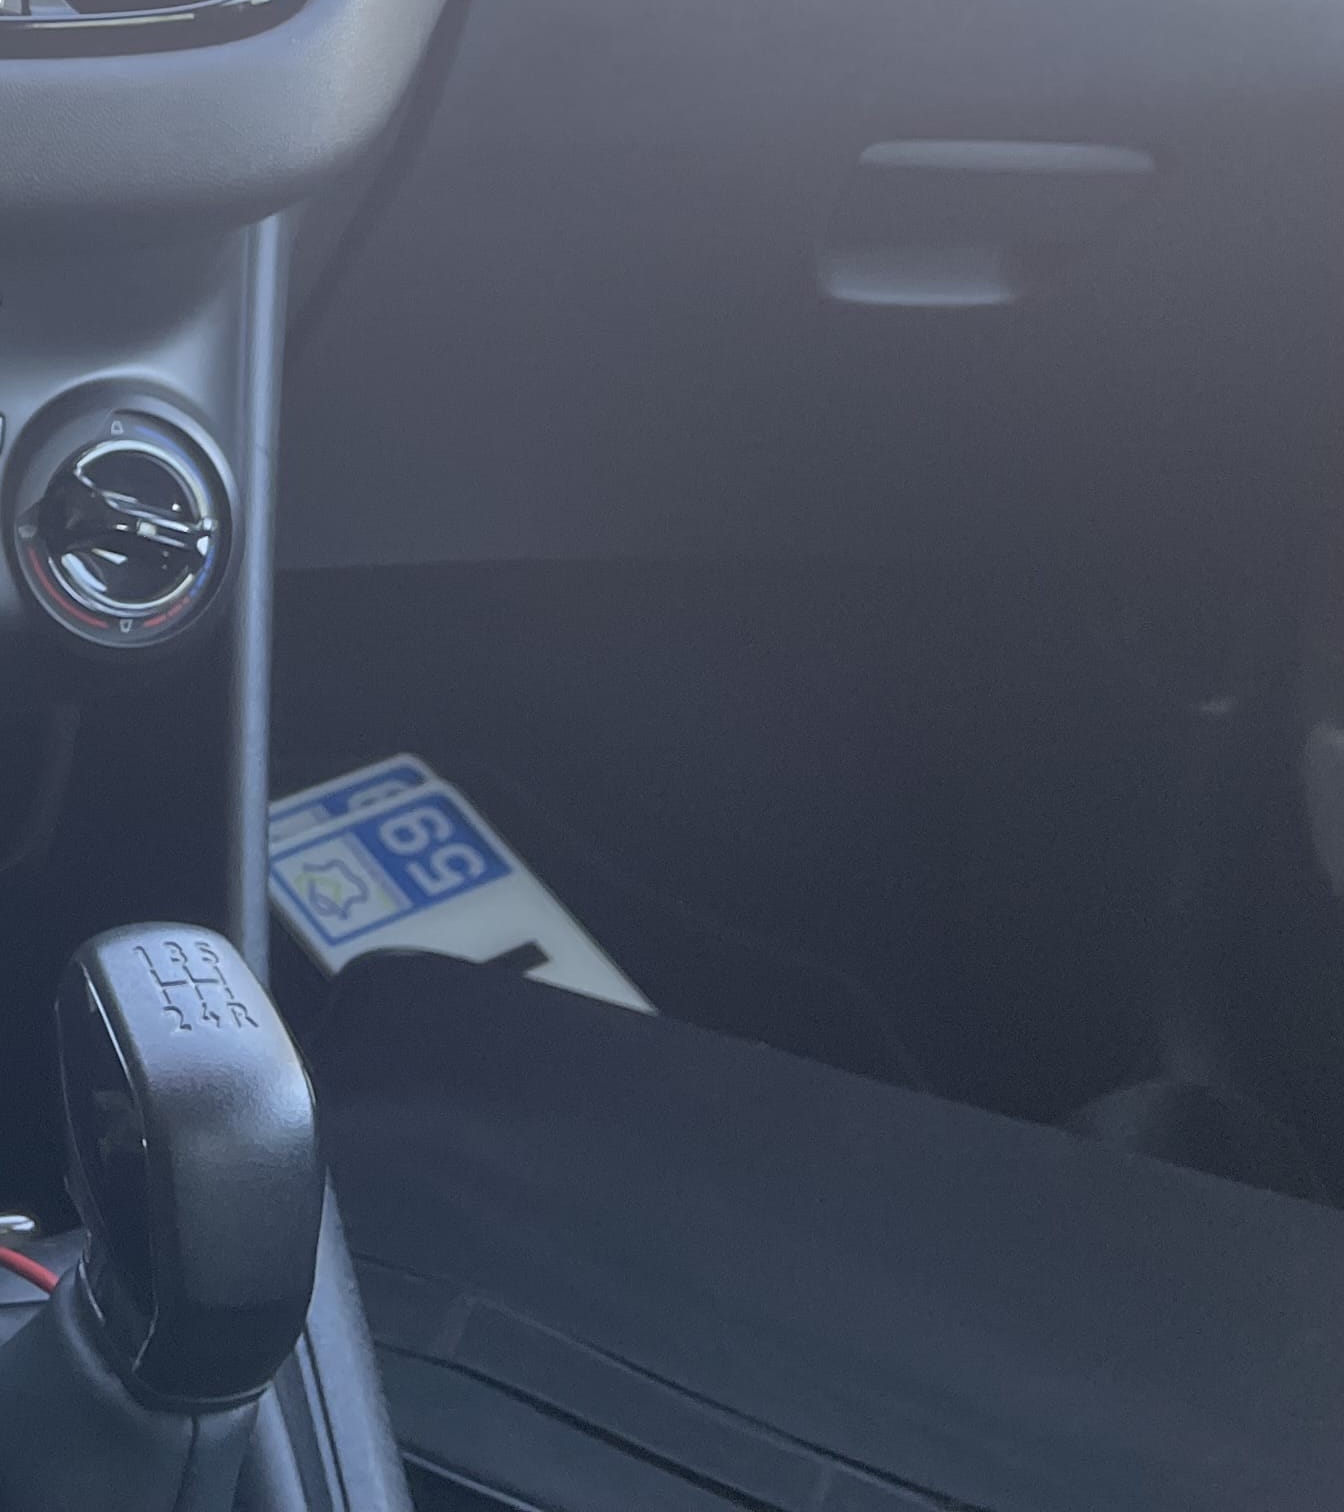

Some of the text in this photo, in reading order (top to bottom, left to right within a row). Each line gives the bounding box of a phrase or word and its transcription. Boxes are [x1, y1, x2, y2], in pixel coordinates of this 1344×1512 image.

[132, 940, 220, 968] 1 3 5
[162, 1001, 259, 1031] 2 4 R
